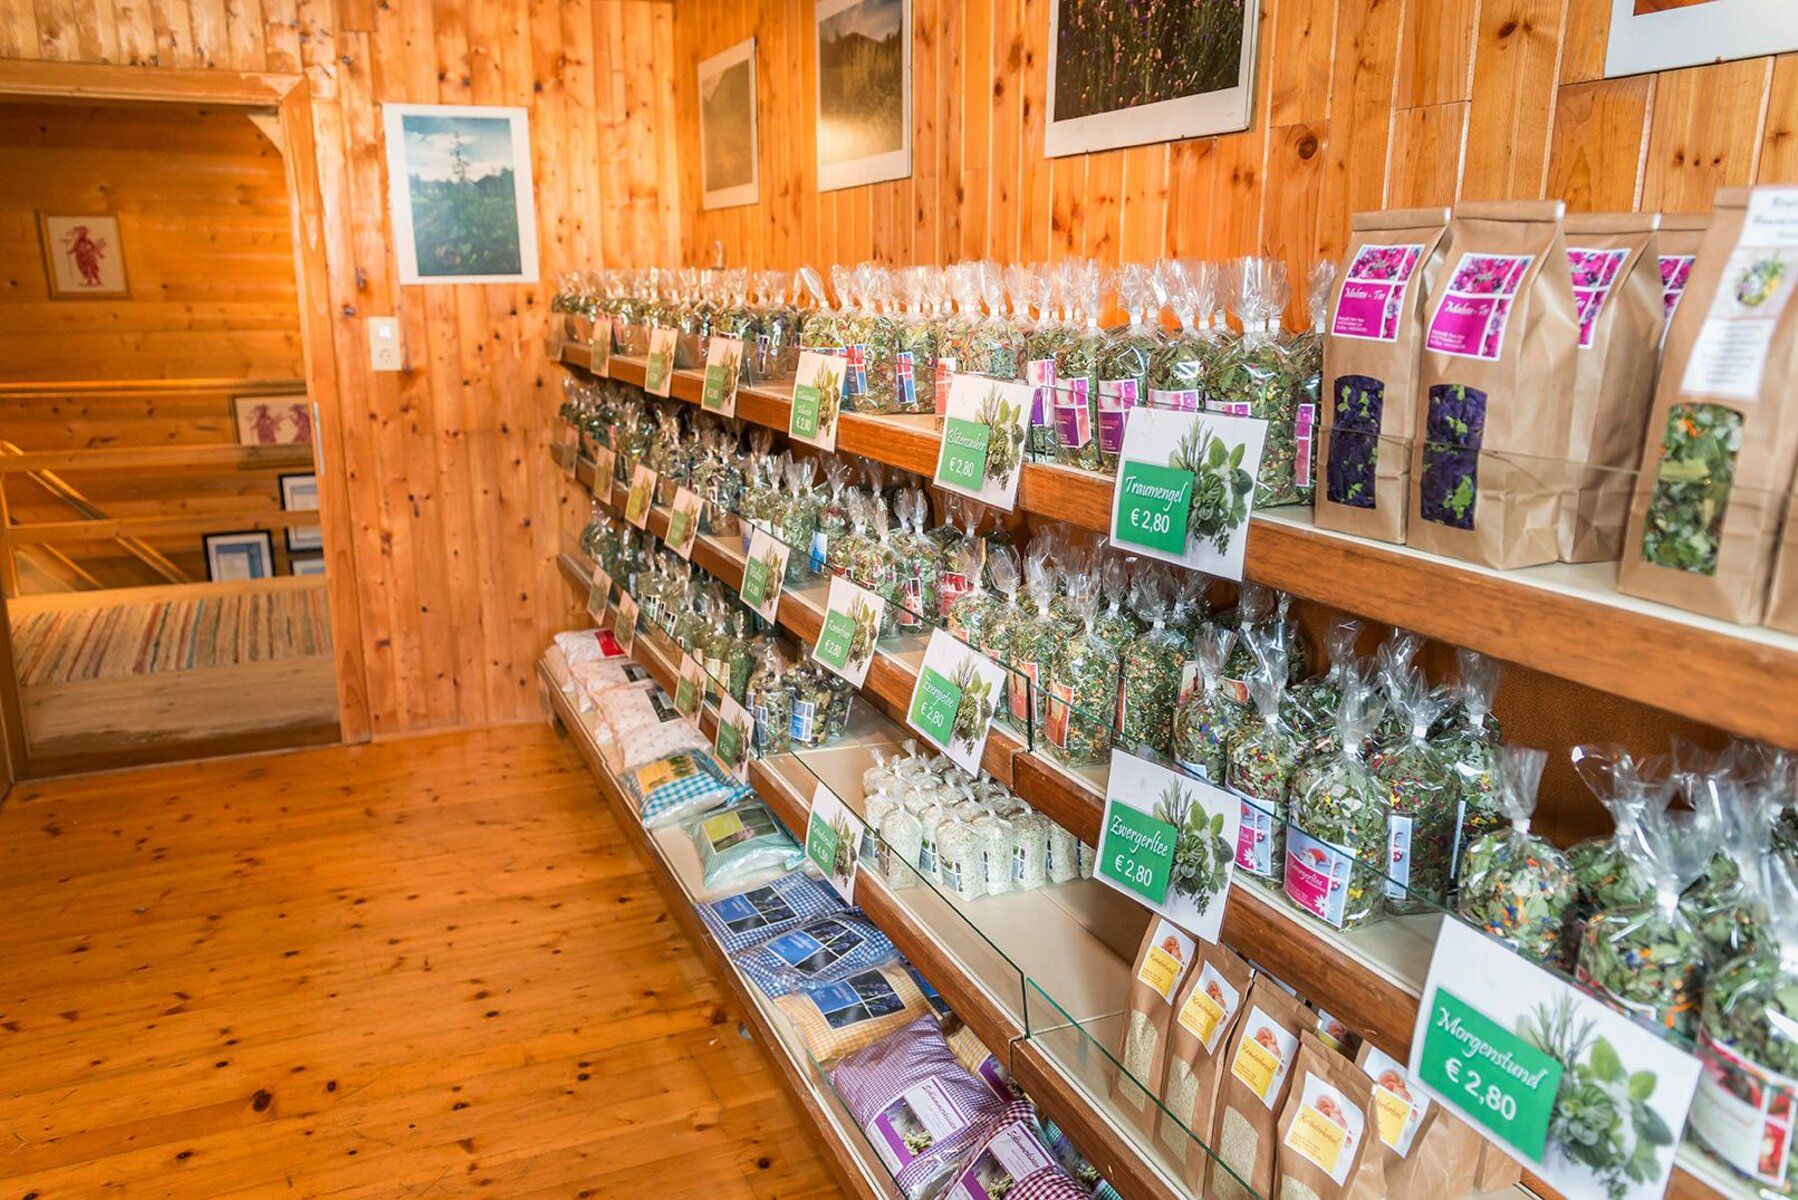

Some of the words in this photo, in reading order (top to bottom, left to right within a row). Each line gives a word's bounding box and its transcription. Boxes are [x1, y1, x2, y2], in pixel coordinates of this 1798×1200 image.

[956, 458, 974, 477] 2,80
[1126, 475, 1189, 512] Traumengel
[1131, 508, 1140, 527] €
[1141, 510, 1170, 534] 2,80
[927, 706, 944, 727] 2,80
[1110, 814, 1169, 857] Zwergerltee
[1115, 854, 1125, 872] €
[1125, 859, 1153, 887] 2,80
[1437, 1006, 1549, 1090] Morgenstund
[1445, 1057, 1462, 1083] €
[1464, 1069, 1517, 1120] 2,80
